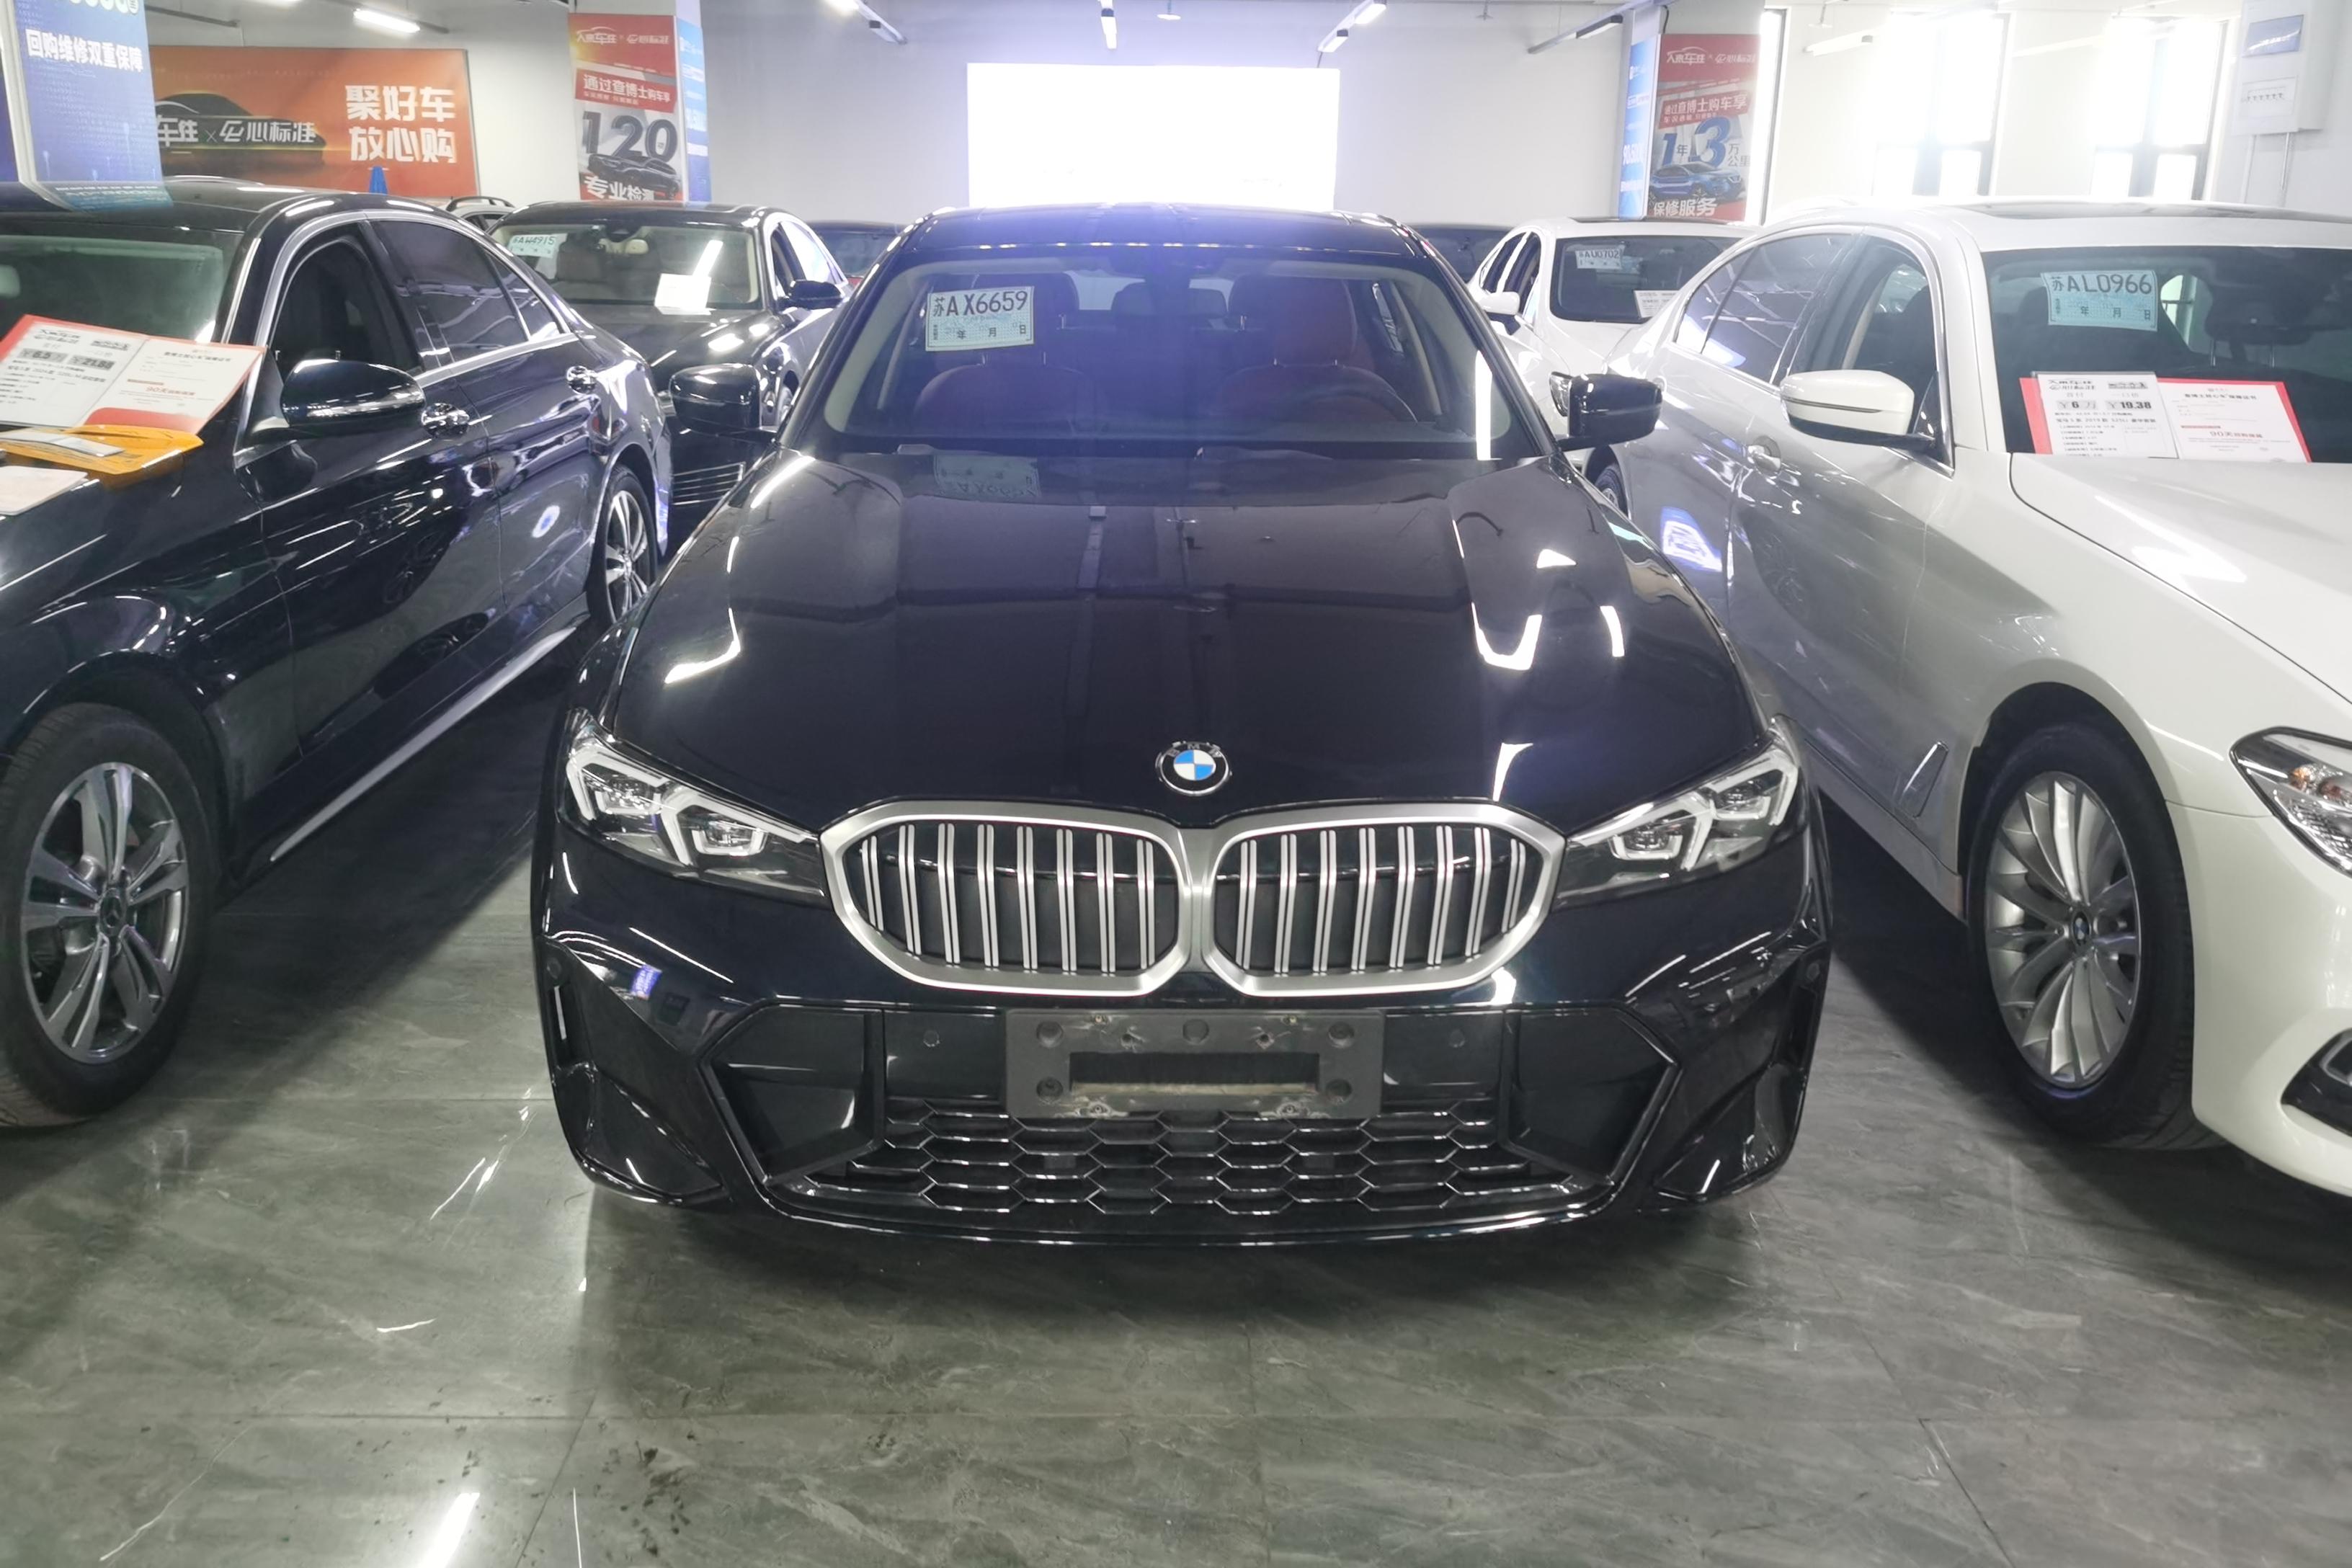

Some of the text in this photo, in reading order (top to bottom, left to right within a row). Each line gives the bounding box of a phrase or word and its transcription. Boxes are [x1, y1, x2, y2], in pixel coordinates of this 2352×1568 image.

[25, 28, 143, 72] 回购维修双重保障
[583, 74, 671, 102] 通过查博士购车享
[344, 85, 456, 122] 聚好车
[1665, 94, 1747, 115] 通过查博士购车享
[349, 126, 458, 164] 放心购
[582, 111, 678, 163] 120
[1653, 197, 1718, 216] 保修服务
[2051, 274, 2152, 294] 苏AL0966
[933, 290, 1028, 317] 苏AX6659
[957, 325, 1026, 339] 年 月 日
